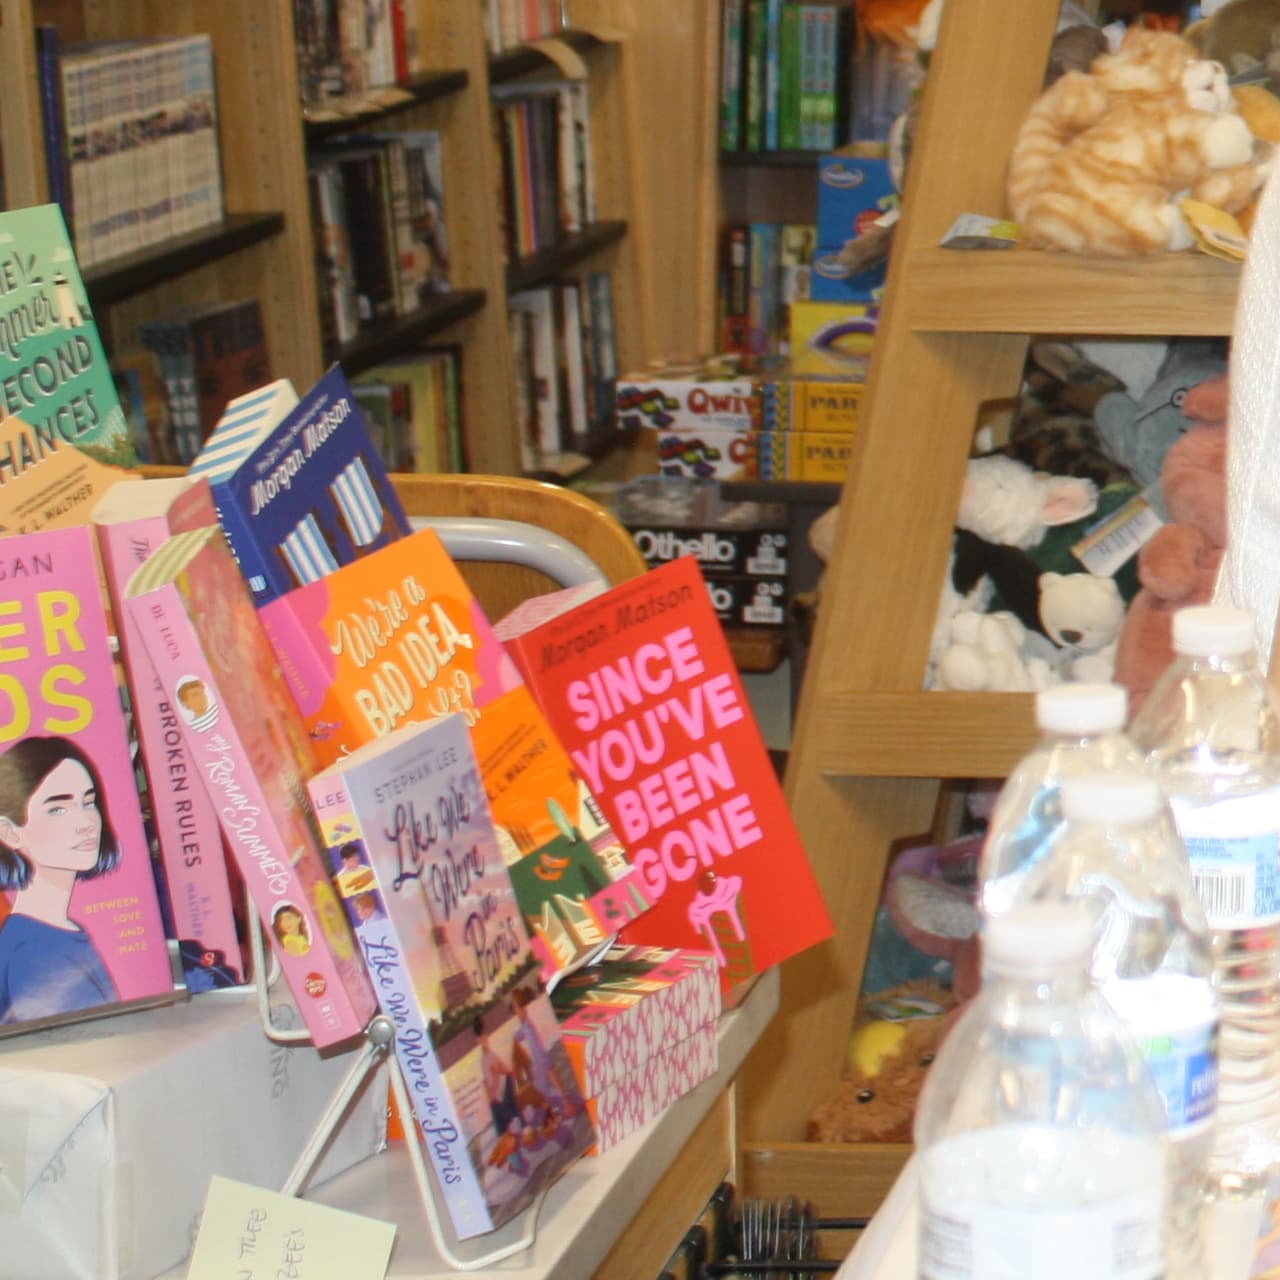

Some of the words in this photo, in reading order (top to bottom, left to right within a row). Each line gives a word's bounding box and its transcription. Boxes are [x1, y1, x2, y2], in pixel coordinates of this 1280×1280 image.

[2, 335, 93, 418] ECOND
[250, 448, 307, 516] Morgan
[302, 397, 352, 458] Matson
[44, 482, 95, 522] WALTHER
[634, 530, 735, 562] Othello
[330, 596, 409, 668] We're
[402, 575, 427, 607] a
[539, 620, 608, 672] Morgan
[612, 582, 693, 639] Matson
[354, 660, 416, 738] BAD
[566, 624, 705, 733] SINCE
[571, 672, 745, 795] YOU'VE
[157, 700, 190, 794] BROKEN
[175, 798, 202, 868] RULES
[206, 758, 252, 812] ROMAN
[314, 791, 347, 811] LEE
[374, 761, 431, 805] STEPHAN
[436, 746, 458, 770] LEE
[613, 740, 737, 844] BEEN
[384, 799, 438, 893] Like
[437, 784, 471, 841] We
[633, 792, 764, 899] GONE
[84, 896, 140, 915] BETWEEN
[431, 844, 486, 919] Were
[113, 911, 143, 924] LOVE
[119, 926, 146, 939] AND
[119, 941, 148, 956] HATE
[463, 910, 521, 994] Paris
[359, 935, 399, 991] Like
[385, 990, 413, 1028] We
[397, 1028, 430, 1093] Were
[424, 1097, 439, 1116] in
[421, 1115, 462, 1186] Paris
